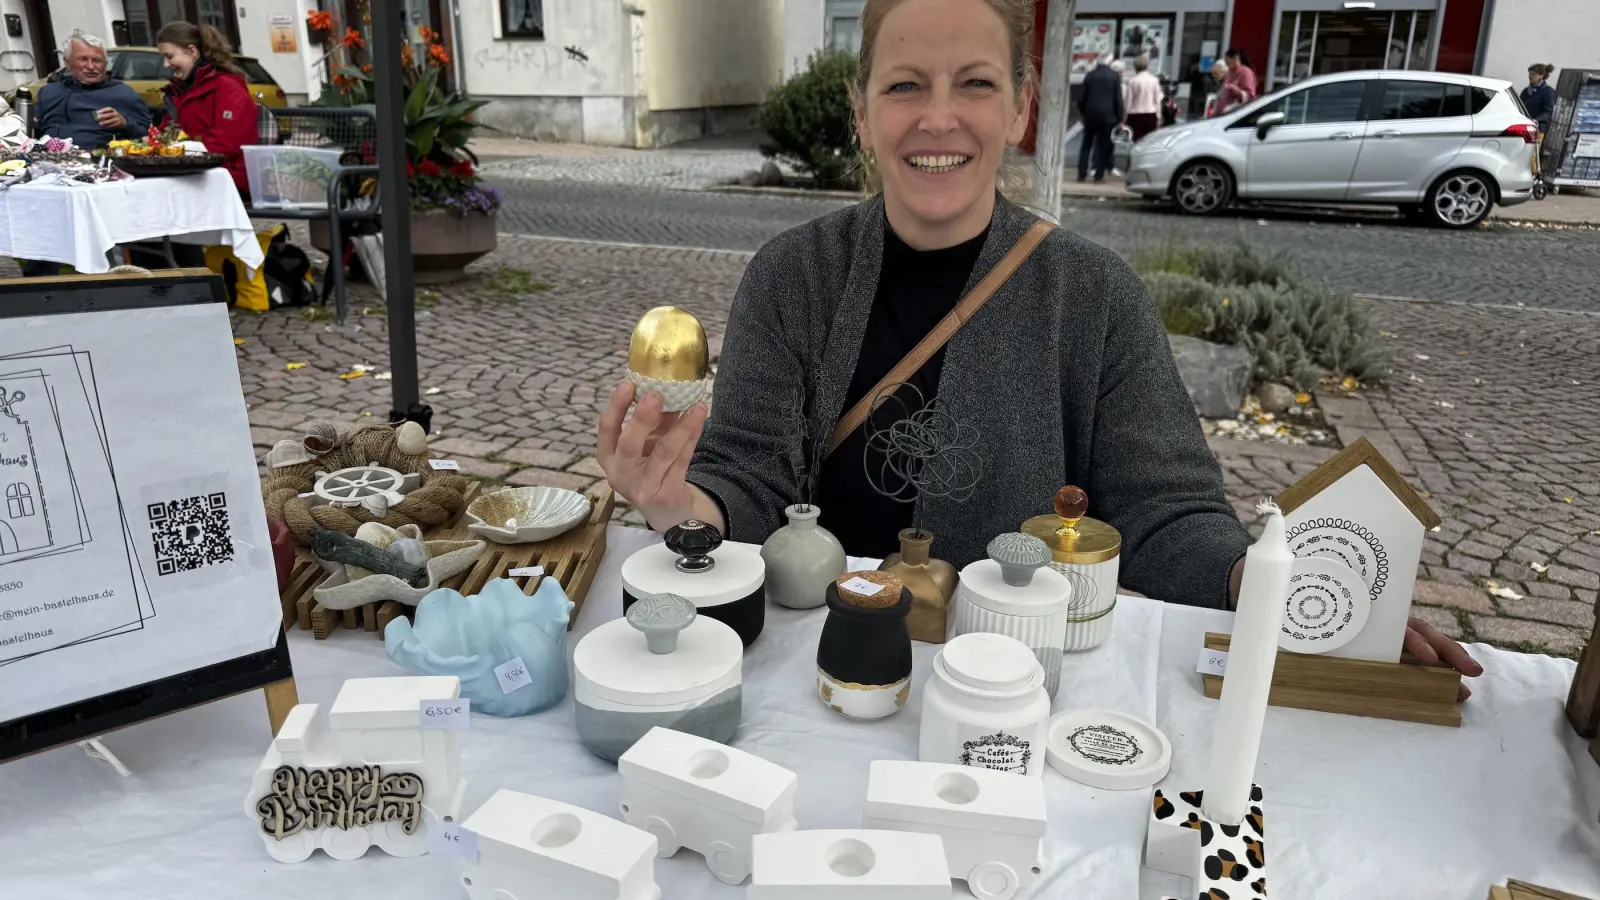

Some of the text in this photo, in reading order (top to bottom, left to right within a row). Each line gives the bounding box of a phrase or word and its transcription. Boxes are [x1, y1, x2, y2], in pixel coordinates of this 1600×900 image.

[425, 706, 462, 718] 6,50€
[987, 748, 1009, 756] Cafés
[256, 790, 422, 841] Birthday
